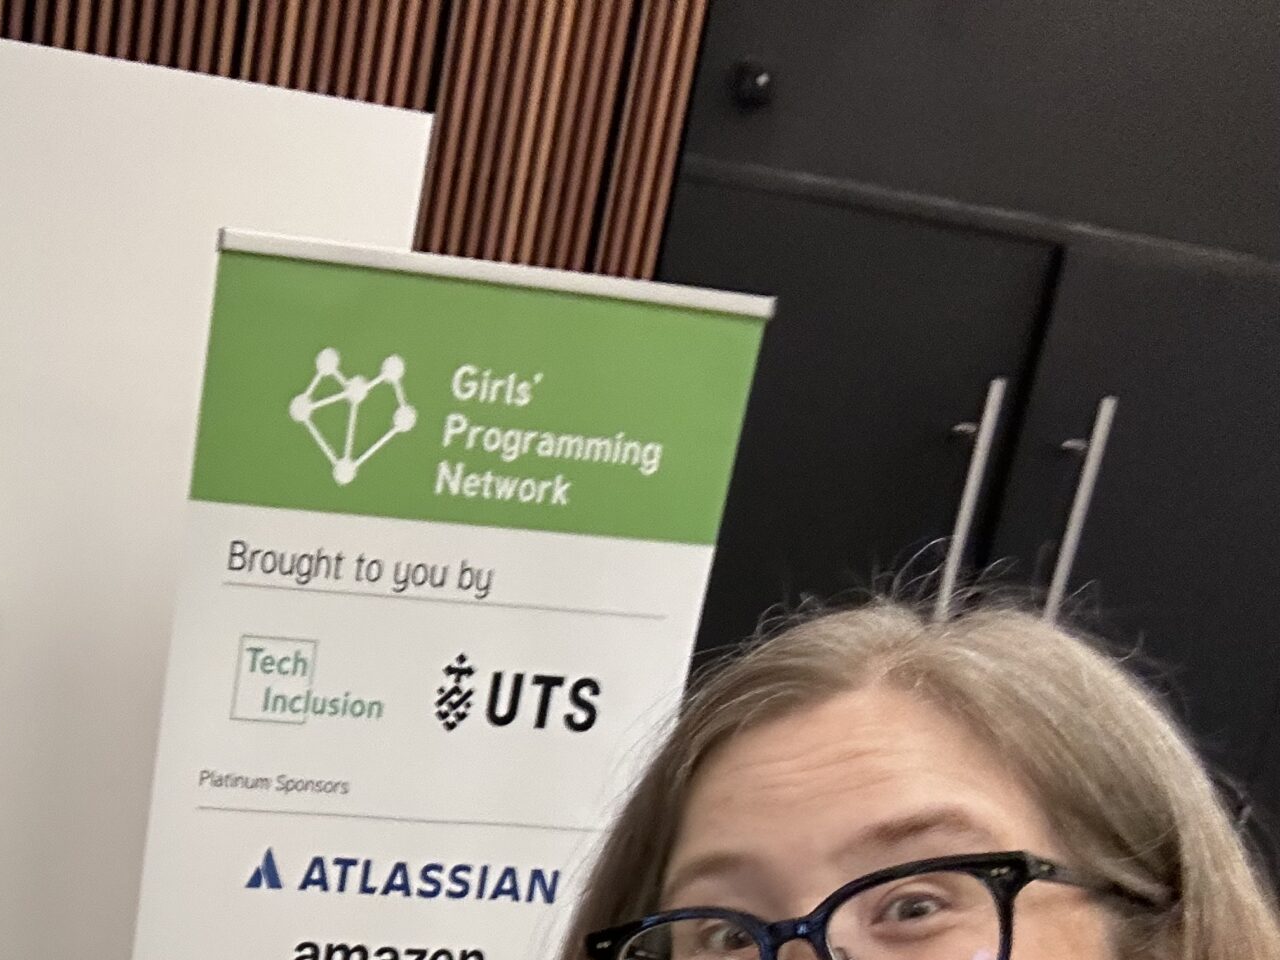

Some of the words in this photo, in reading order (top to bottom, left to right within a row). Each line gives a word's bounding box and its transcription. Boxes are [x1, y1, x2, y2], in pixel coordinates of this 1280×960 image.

[450, 364, 544, 408] Girls'
[441, 413, 664, 476] Programming
[434, 460, 573, 507] Network
[226, 539, 345, 587] Brought
[354, 552, 384, 583] to
[391, 560, 449, 594] you
[456, 557, 494, 600] by
[245, 646, 310, 678] Tech
[261, 686, 385, 720] Inclusion
[486, 670, 602, 733] UTS
[198, 769, 272, 794] Platinum
[275, 774, 350, 796] Sponsors
[298, 856, 562, 904] ATLASSIAN
